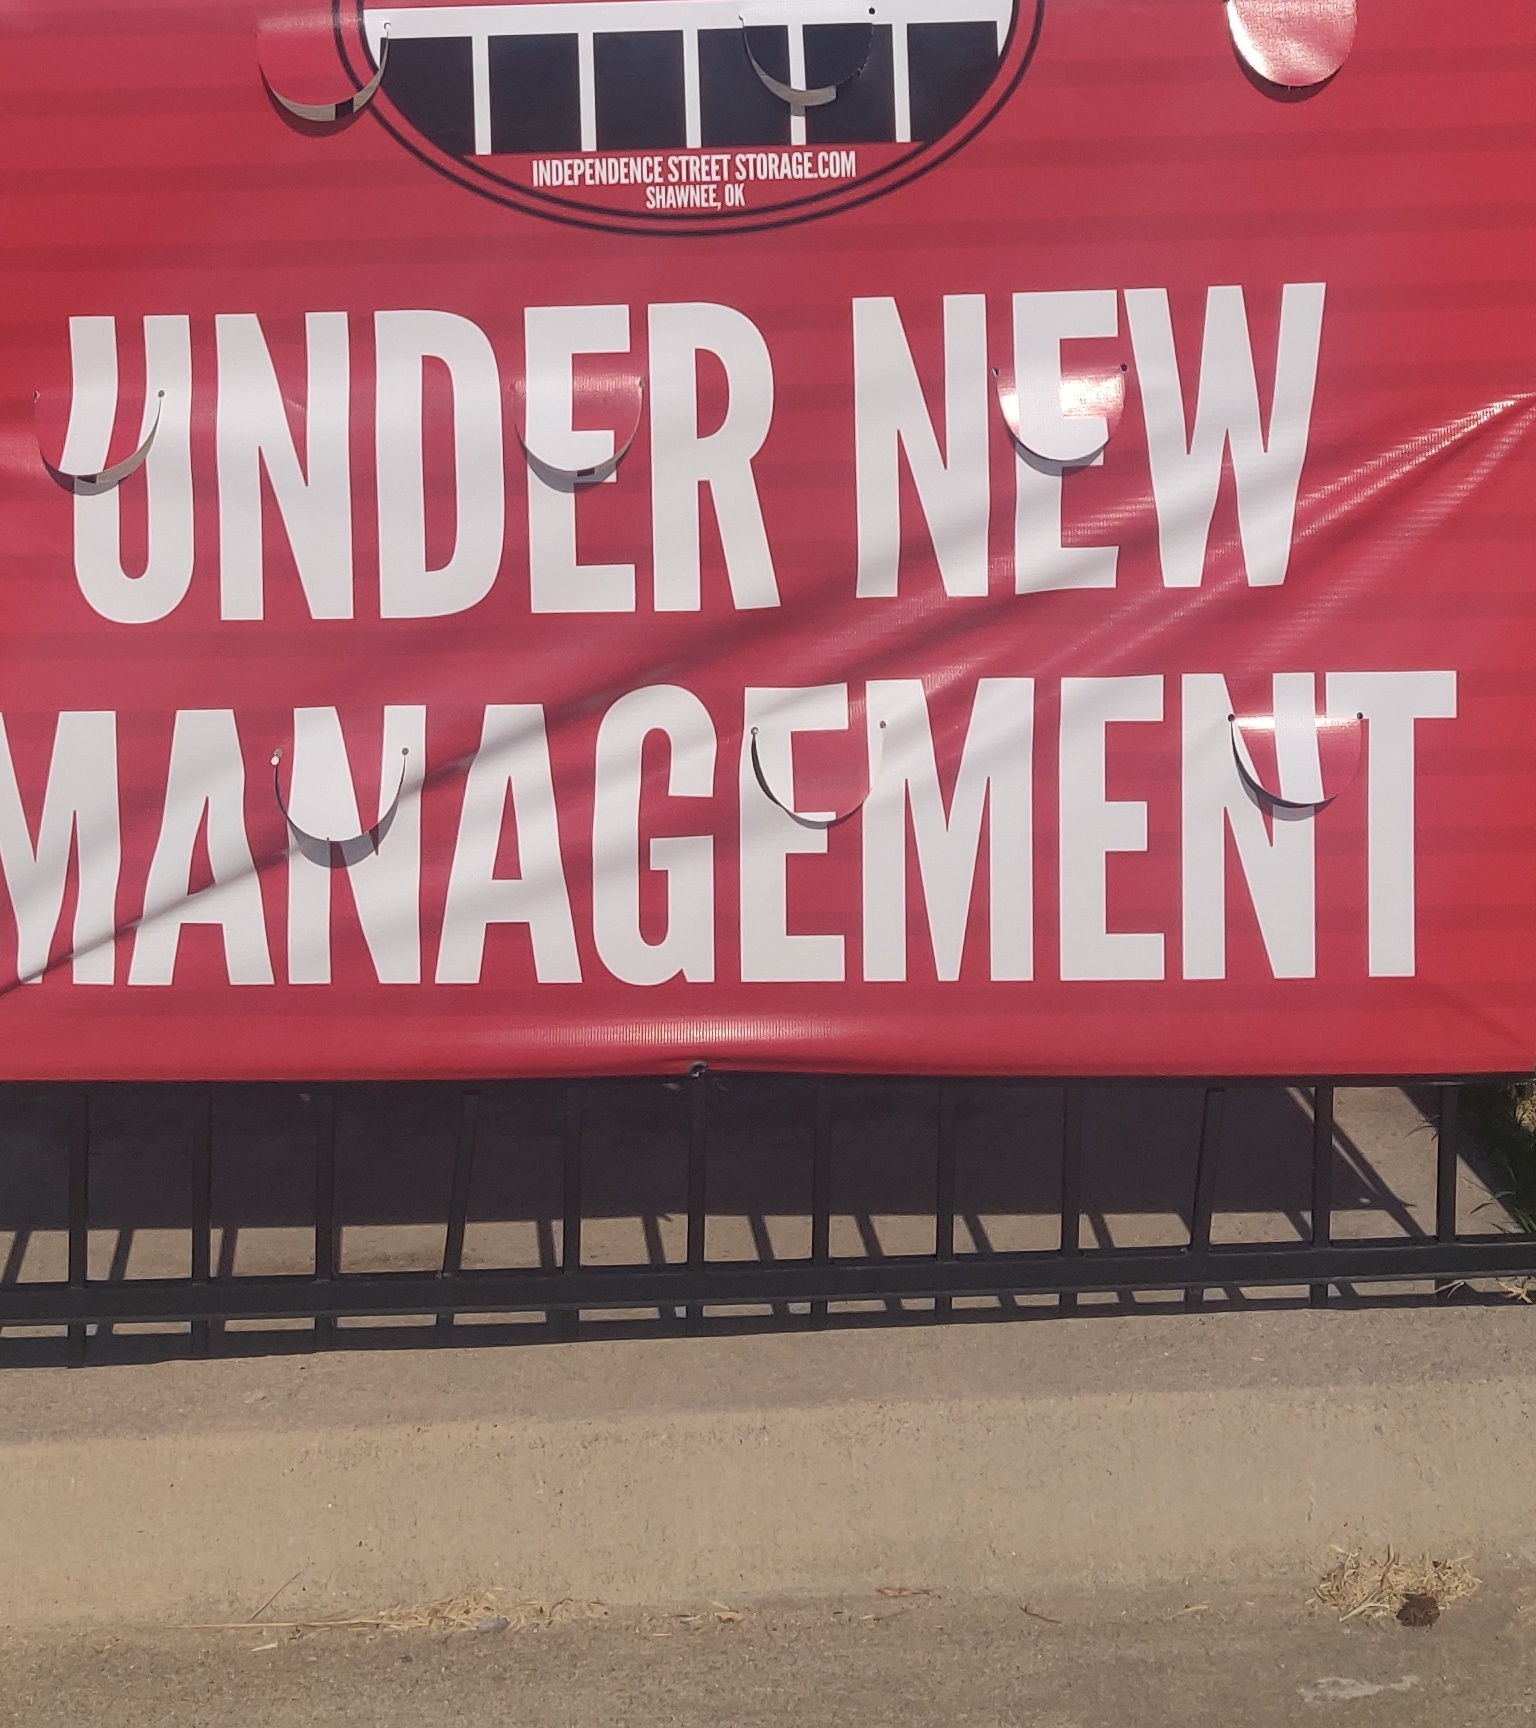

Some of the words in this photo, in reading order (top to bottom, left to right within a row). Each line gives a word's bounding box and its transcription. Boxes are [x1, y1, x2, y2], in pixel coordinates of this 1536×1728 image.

[532, 157, 664, 187] INDEPENDENCE
[666, 154, 733, 183] STREET
[734, 151, 856, 181] STORAGE.COM
[645, 183, 721, 212] SHAWNEE,
[723, 183, 745, 207] OK
[66, 300, 784, 624] UNDER
[852, 281, 1327, 599] NEW
